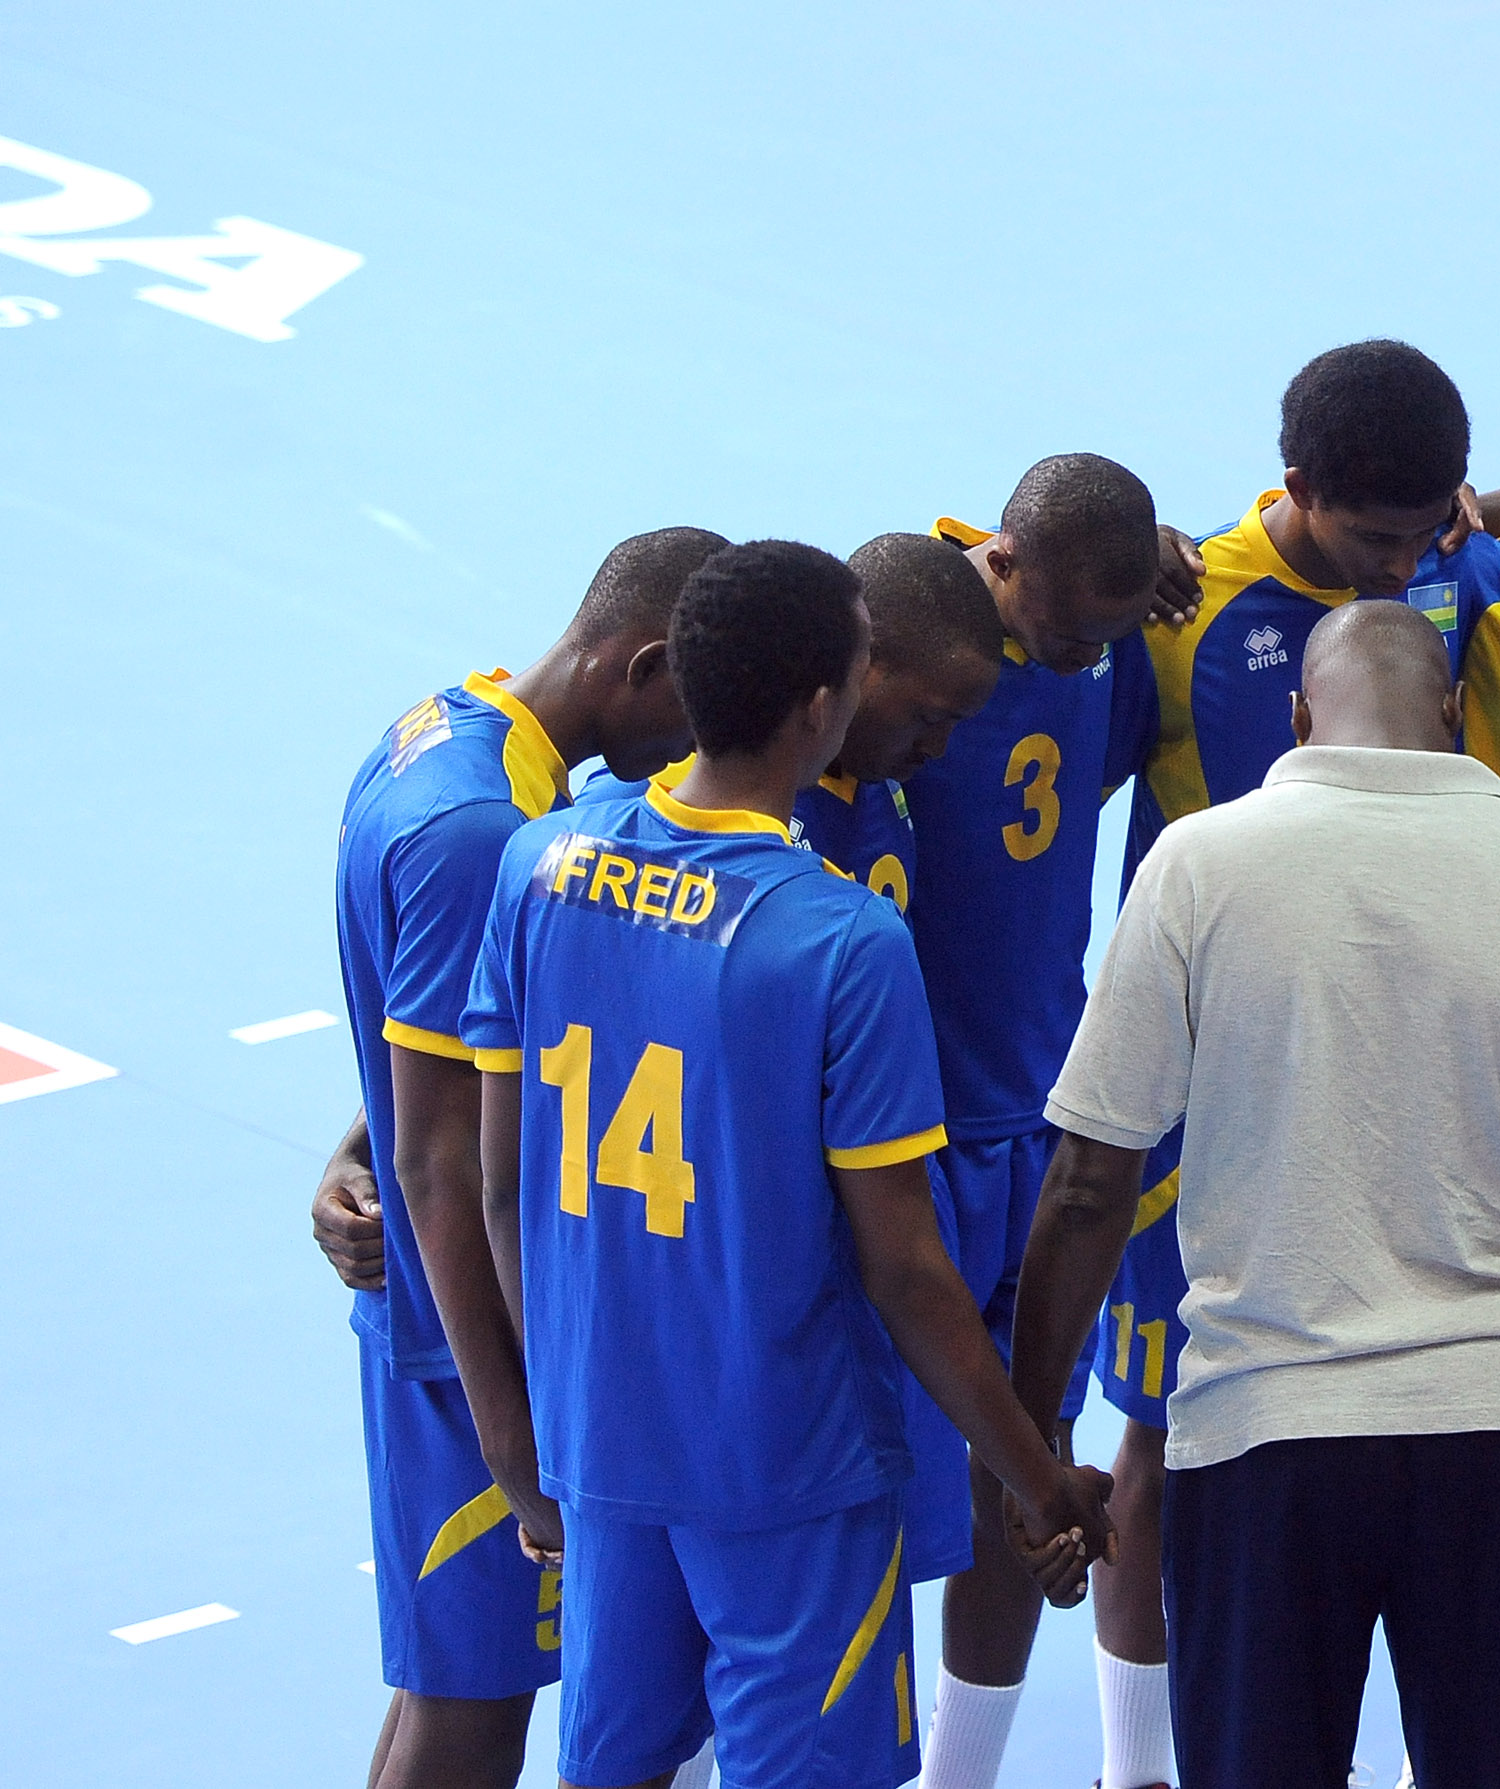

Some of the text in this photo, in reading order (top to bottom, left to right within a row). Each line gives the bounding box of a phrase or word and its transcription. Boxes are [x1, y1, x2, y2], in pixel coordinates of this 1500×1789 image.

[1247, 649, 1289, 671] errea
[1002, 732, 1061, 861] 3
[553, 847, 717, 925] FRED
[540, 1023, 696, 1239] 14
[1111, 1302, 1167, 1399] 11
